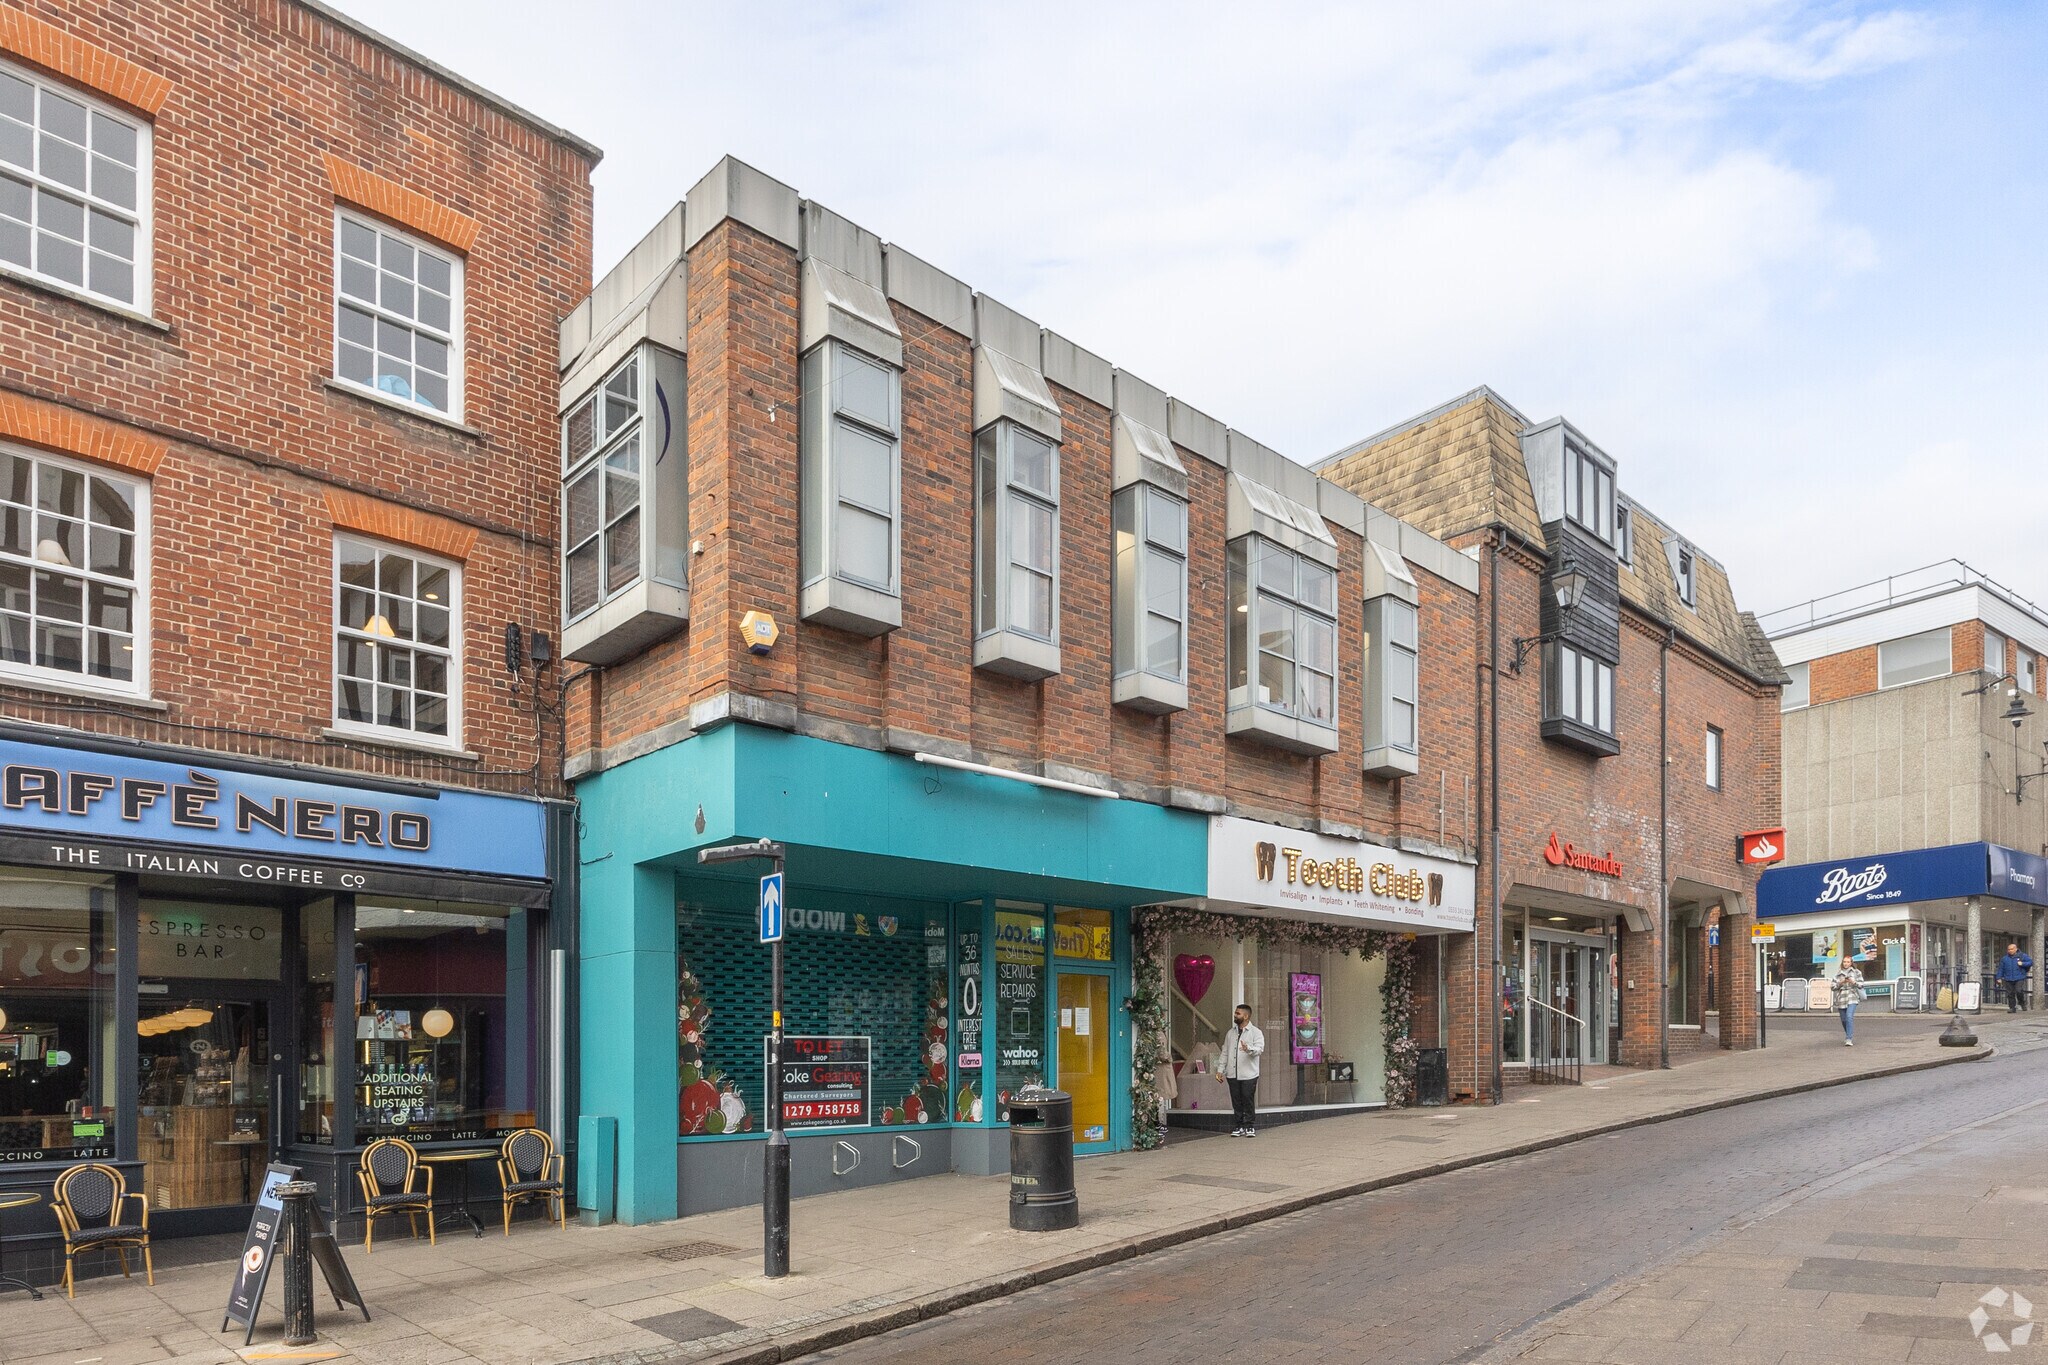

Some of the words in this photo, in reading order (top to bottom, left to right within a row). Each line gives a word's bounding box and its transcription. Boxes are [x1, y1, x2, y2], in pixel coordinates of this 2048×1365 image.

[235, 790, 431, 851] NERO
[51, 846, 100, 864] THE
[127, 853, 219, 874] ITALIAN
[239, 864, 323, 885] COFFEE
[1564, 841, 1624, 877] Santander
[1282, 847, 1363, 893] Tooth
[1369, 862, 1424, 903] Club
[2010, 868, 2035, 890] Pharmacy
[1815, 863, 1887, 904] Boots
[1866, 893, 1884, 901] Since
[1886, 890, 1902, 899] 1849
[1280, 889, 1307, 902] Invisalign
[1319, 895, 1343, 906] Implants
[1354, 899, 1368, 909] Teeth
[1369, 901, 1395, 914] Whitening
[1405, 906, 1424, 917] Bonding
[960, 934, 968, 945] UP
[970, 933, 978, 944] TO
[1882, 937, 1899, 946] Click
[1899, 936, 1906, 944] &
[176, 943, 224, 958] BAR
[965, 945, 976, 961] 36
[1006, 944, 1034, 960] SALES
[960, 962, 980, 976] MONTHS
[1001, 965, 1036, 979] SERVICE
[1001, 983, 1036, 998] REPAIRS
[1902, 981, 1914, 991] 15
[958, 1019, 982, 1032] INTEREST
[963, 1032, 977, 1044] FREE
[794, 1040, 814, 1053] TO
[818, 1040, 843, 1053] LET
[1003, 1045, 1038, 1058] wahoo
[961, 1055, 980, 1066] Klarna
[363, 1073, 433, 1083] ADDITIONAL
[783, 1068, 809, 1083] oke
[812, 1067, 861, 1085] Gearing
[374, 1085, 423, 1096] SEATING
[820, 1091, 854, 1099] Surveyors
[373, 1098, 424, 1108] UPSTAIRS
[818, 1104, 859, 1115] 758758
[452, 1131, 477, 1139] LATTE
[73, 1148, 108, 1157] LATTE
